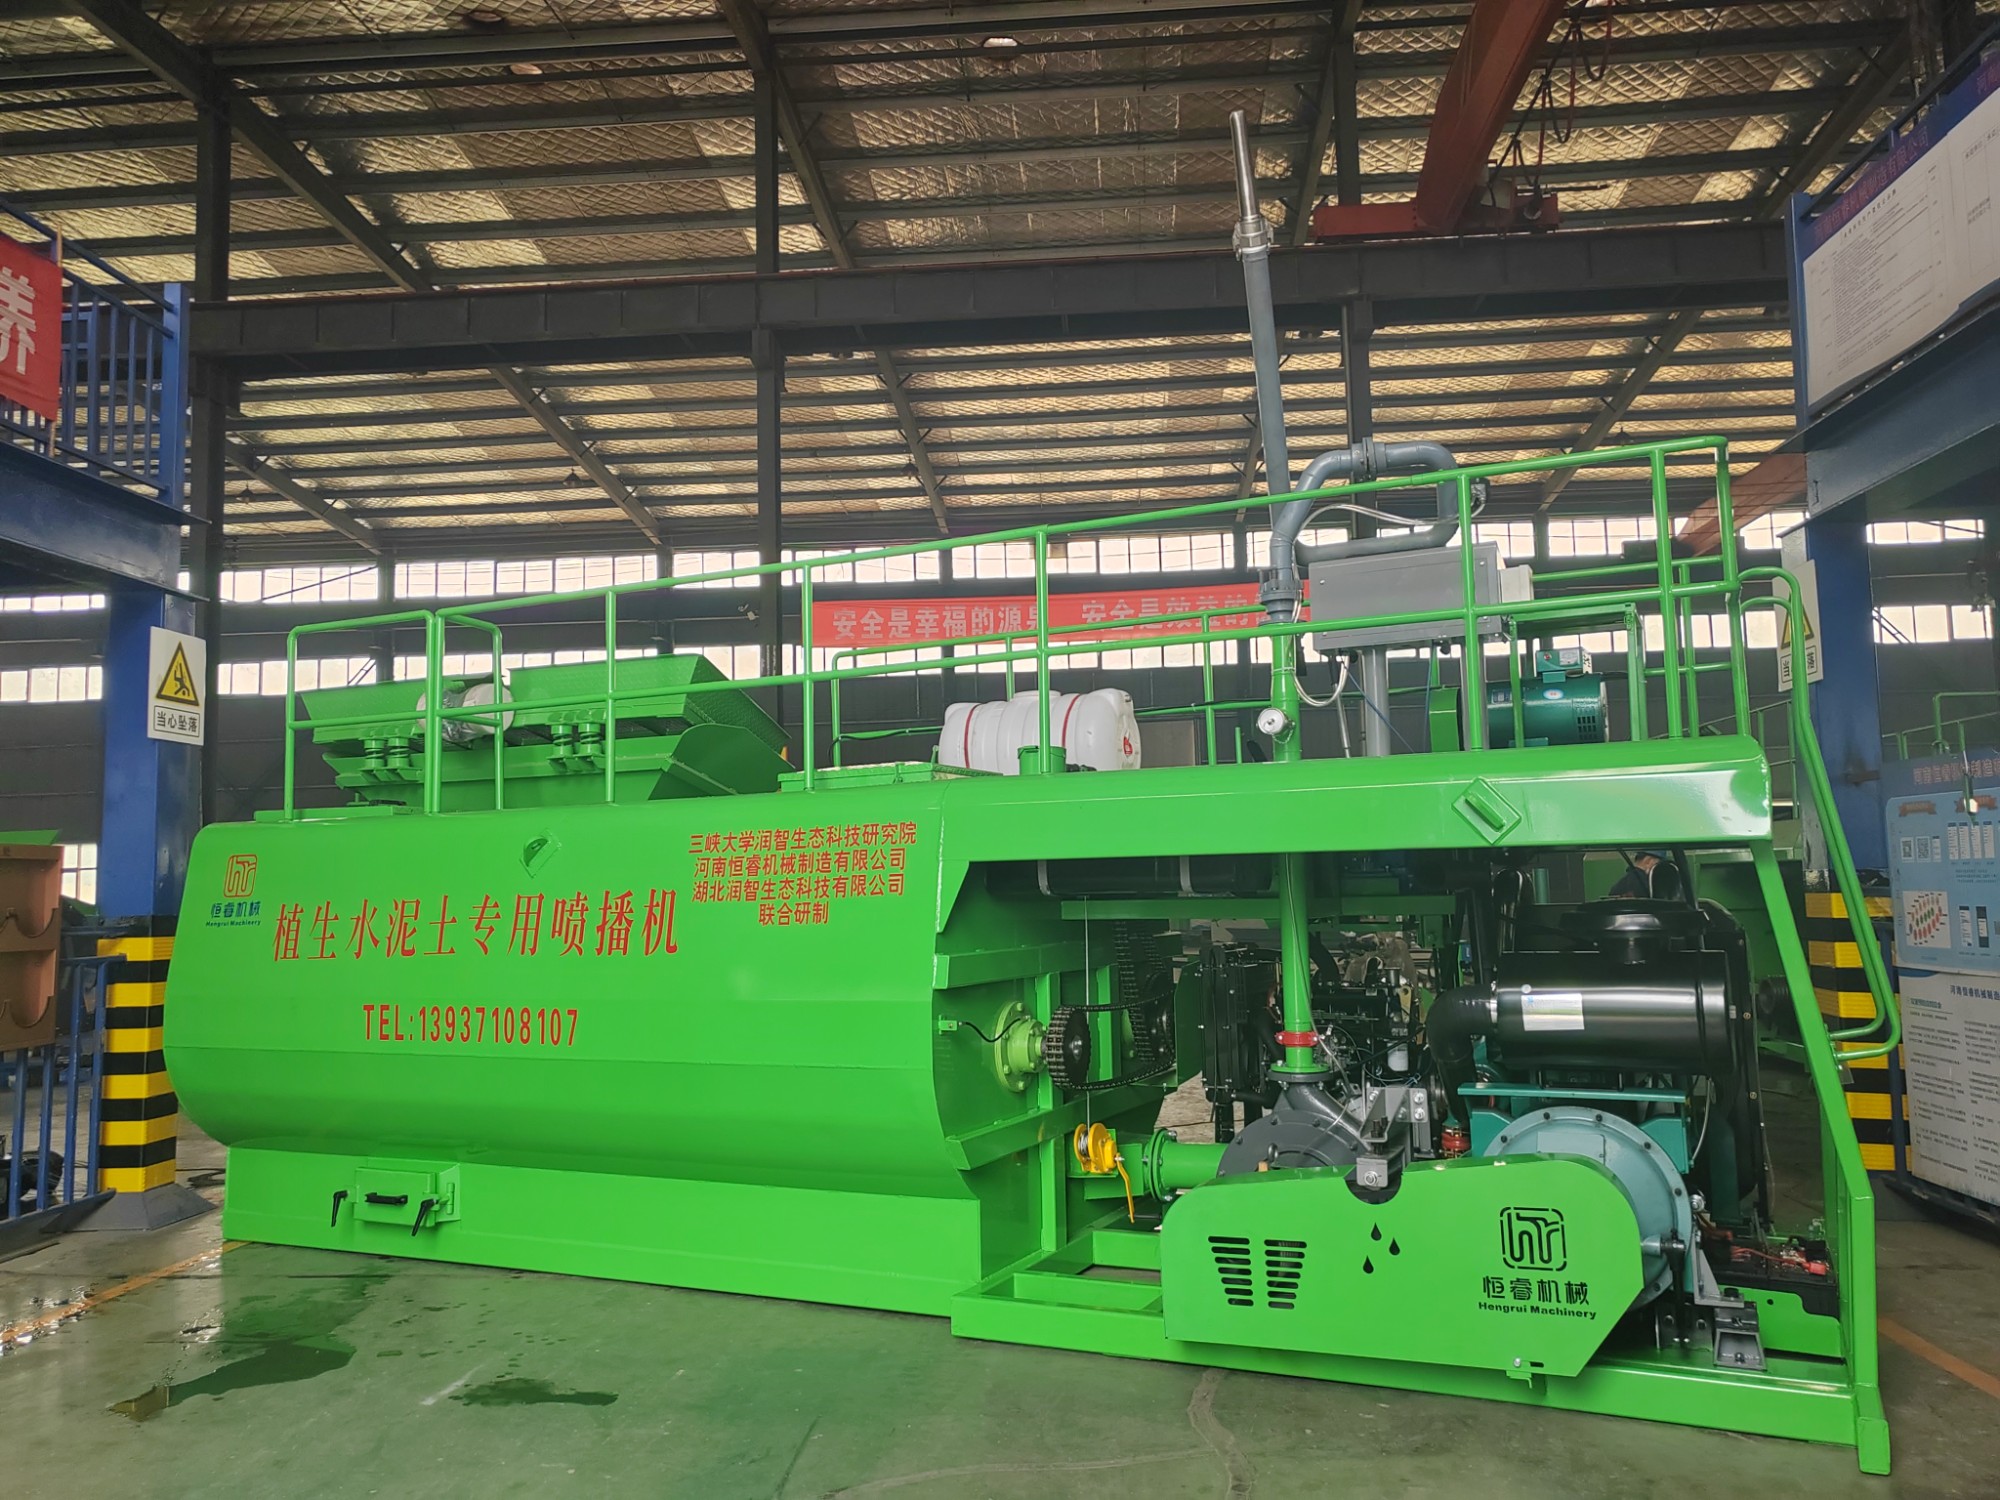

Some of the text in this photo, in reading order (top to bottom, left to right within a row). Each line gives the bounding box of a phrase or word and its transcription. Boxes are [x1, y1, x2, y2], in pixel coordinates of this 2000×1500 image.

[1783, 652, 1815, 677] 当落
[157, 711, 198, 732] 当心坠落
[689, 821, 917, 854] 三峡大学润智生态科技研究院
[694, 847, 906, 879] 河南恒睿机械制造有限公司
[691, 873, 905, 903] 湖北润智生态科技有限公司
[210, 900, 261, 918] 恒睿机械
[758, 901, 829, 926] 联合研制
[272, 888, 679, 962] 植生水泥土专用喷播机
[363, 1004, 578, 1046] TEL:13937108107
[1482, 1275, 1589, 1305] 恒睿机械
[1478, 1301, 1597, 1320] Hengrui Machinery
